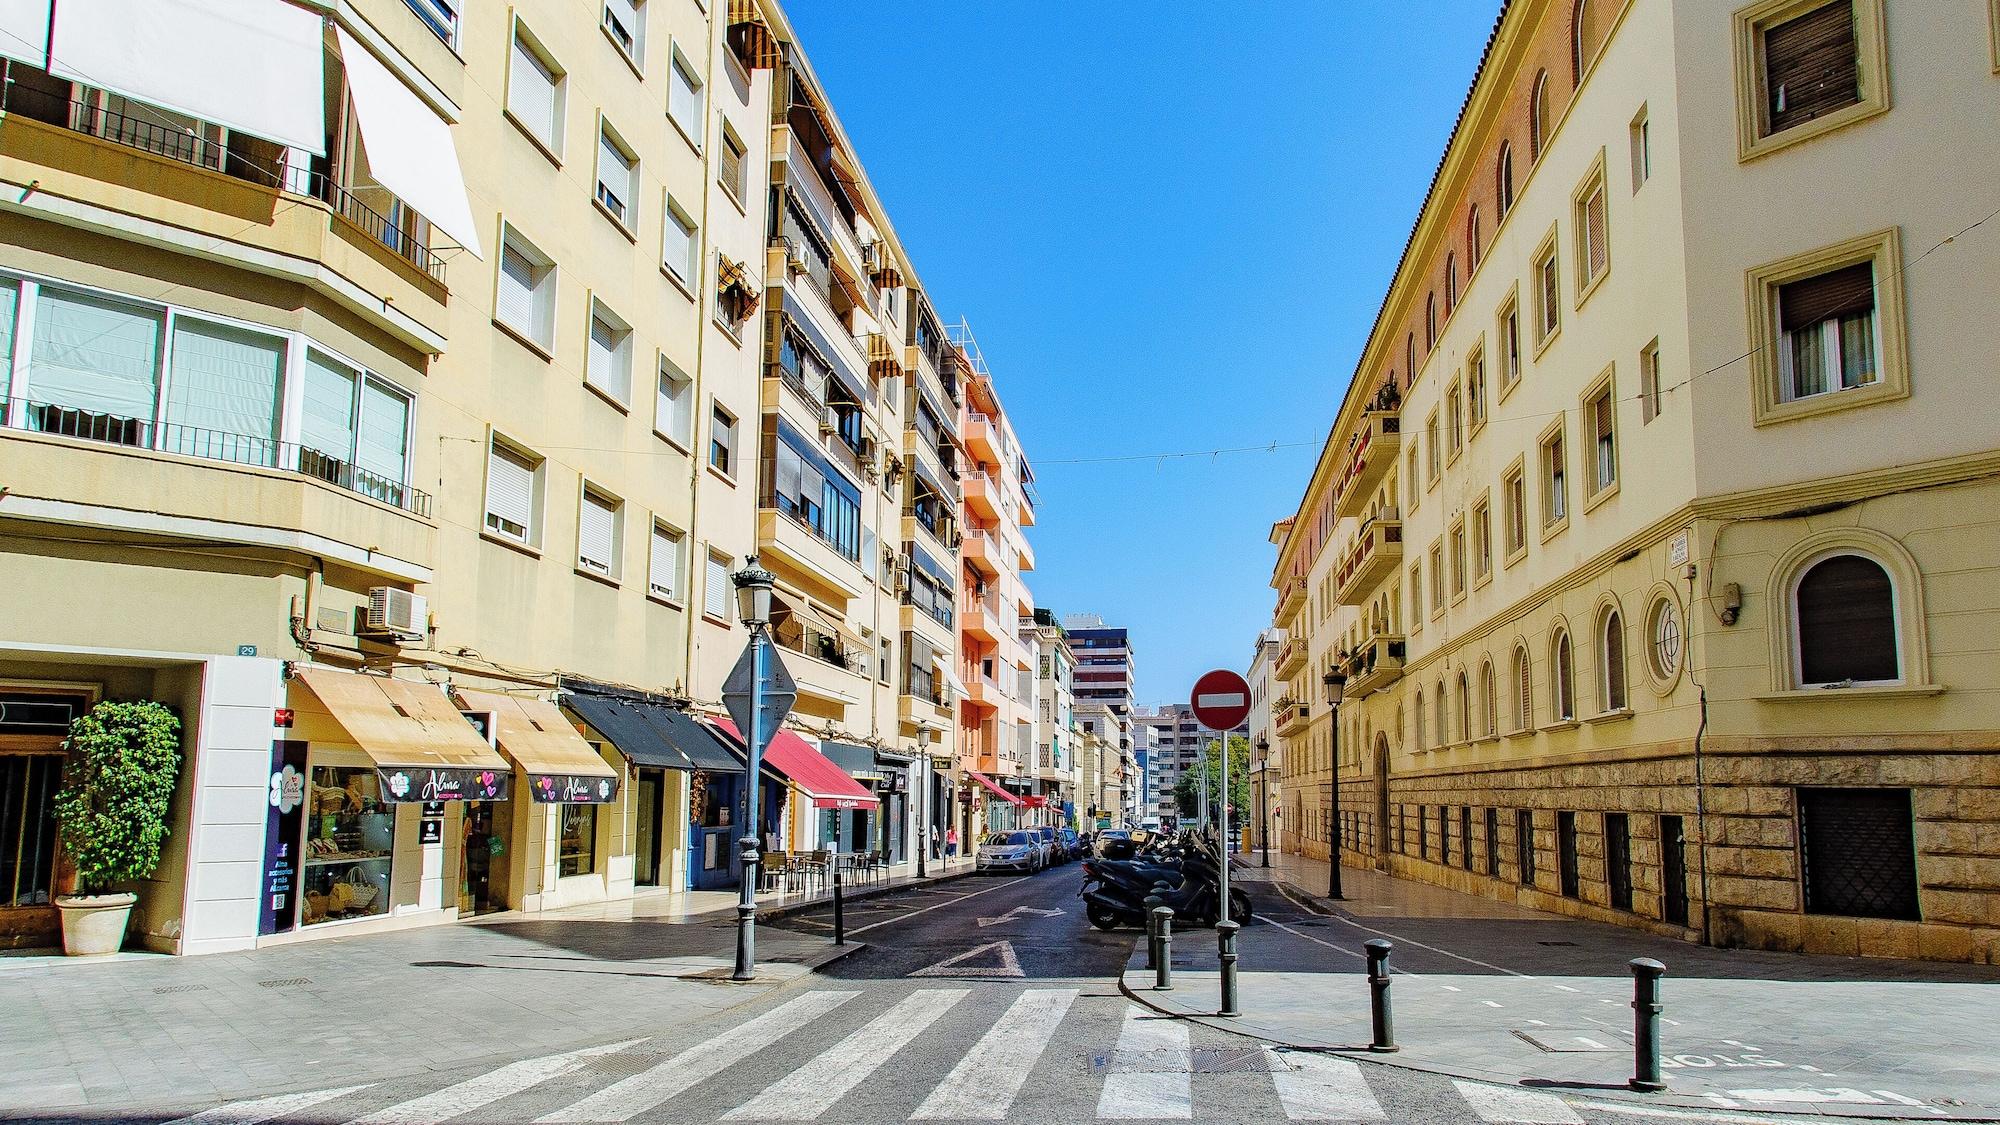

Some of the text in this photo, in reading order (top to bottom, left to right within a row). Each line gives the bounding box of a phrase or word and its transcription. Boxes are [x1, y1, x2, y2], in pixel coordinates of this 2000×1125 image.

[241, 646, 254, 655] 29
[422, 769, 460, 799] Alma
[563, 776, 589, 800] Alma
